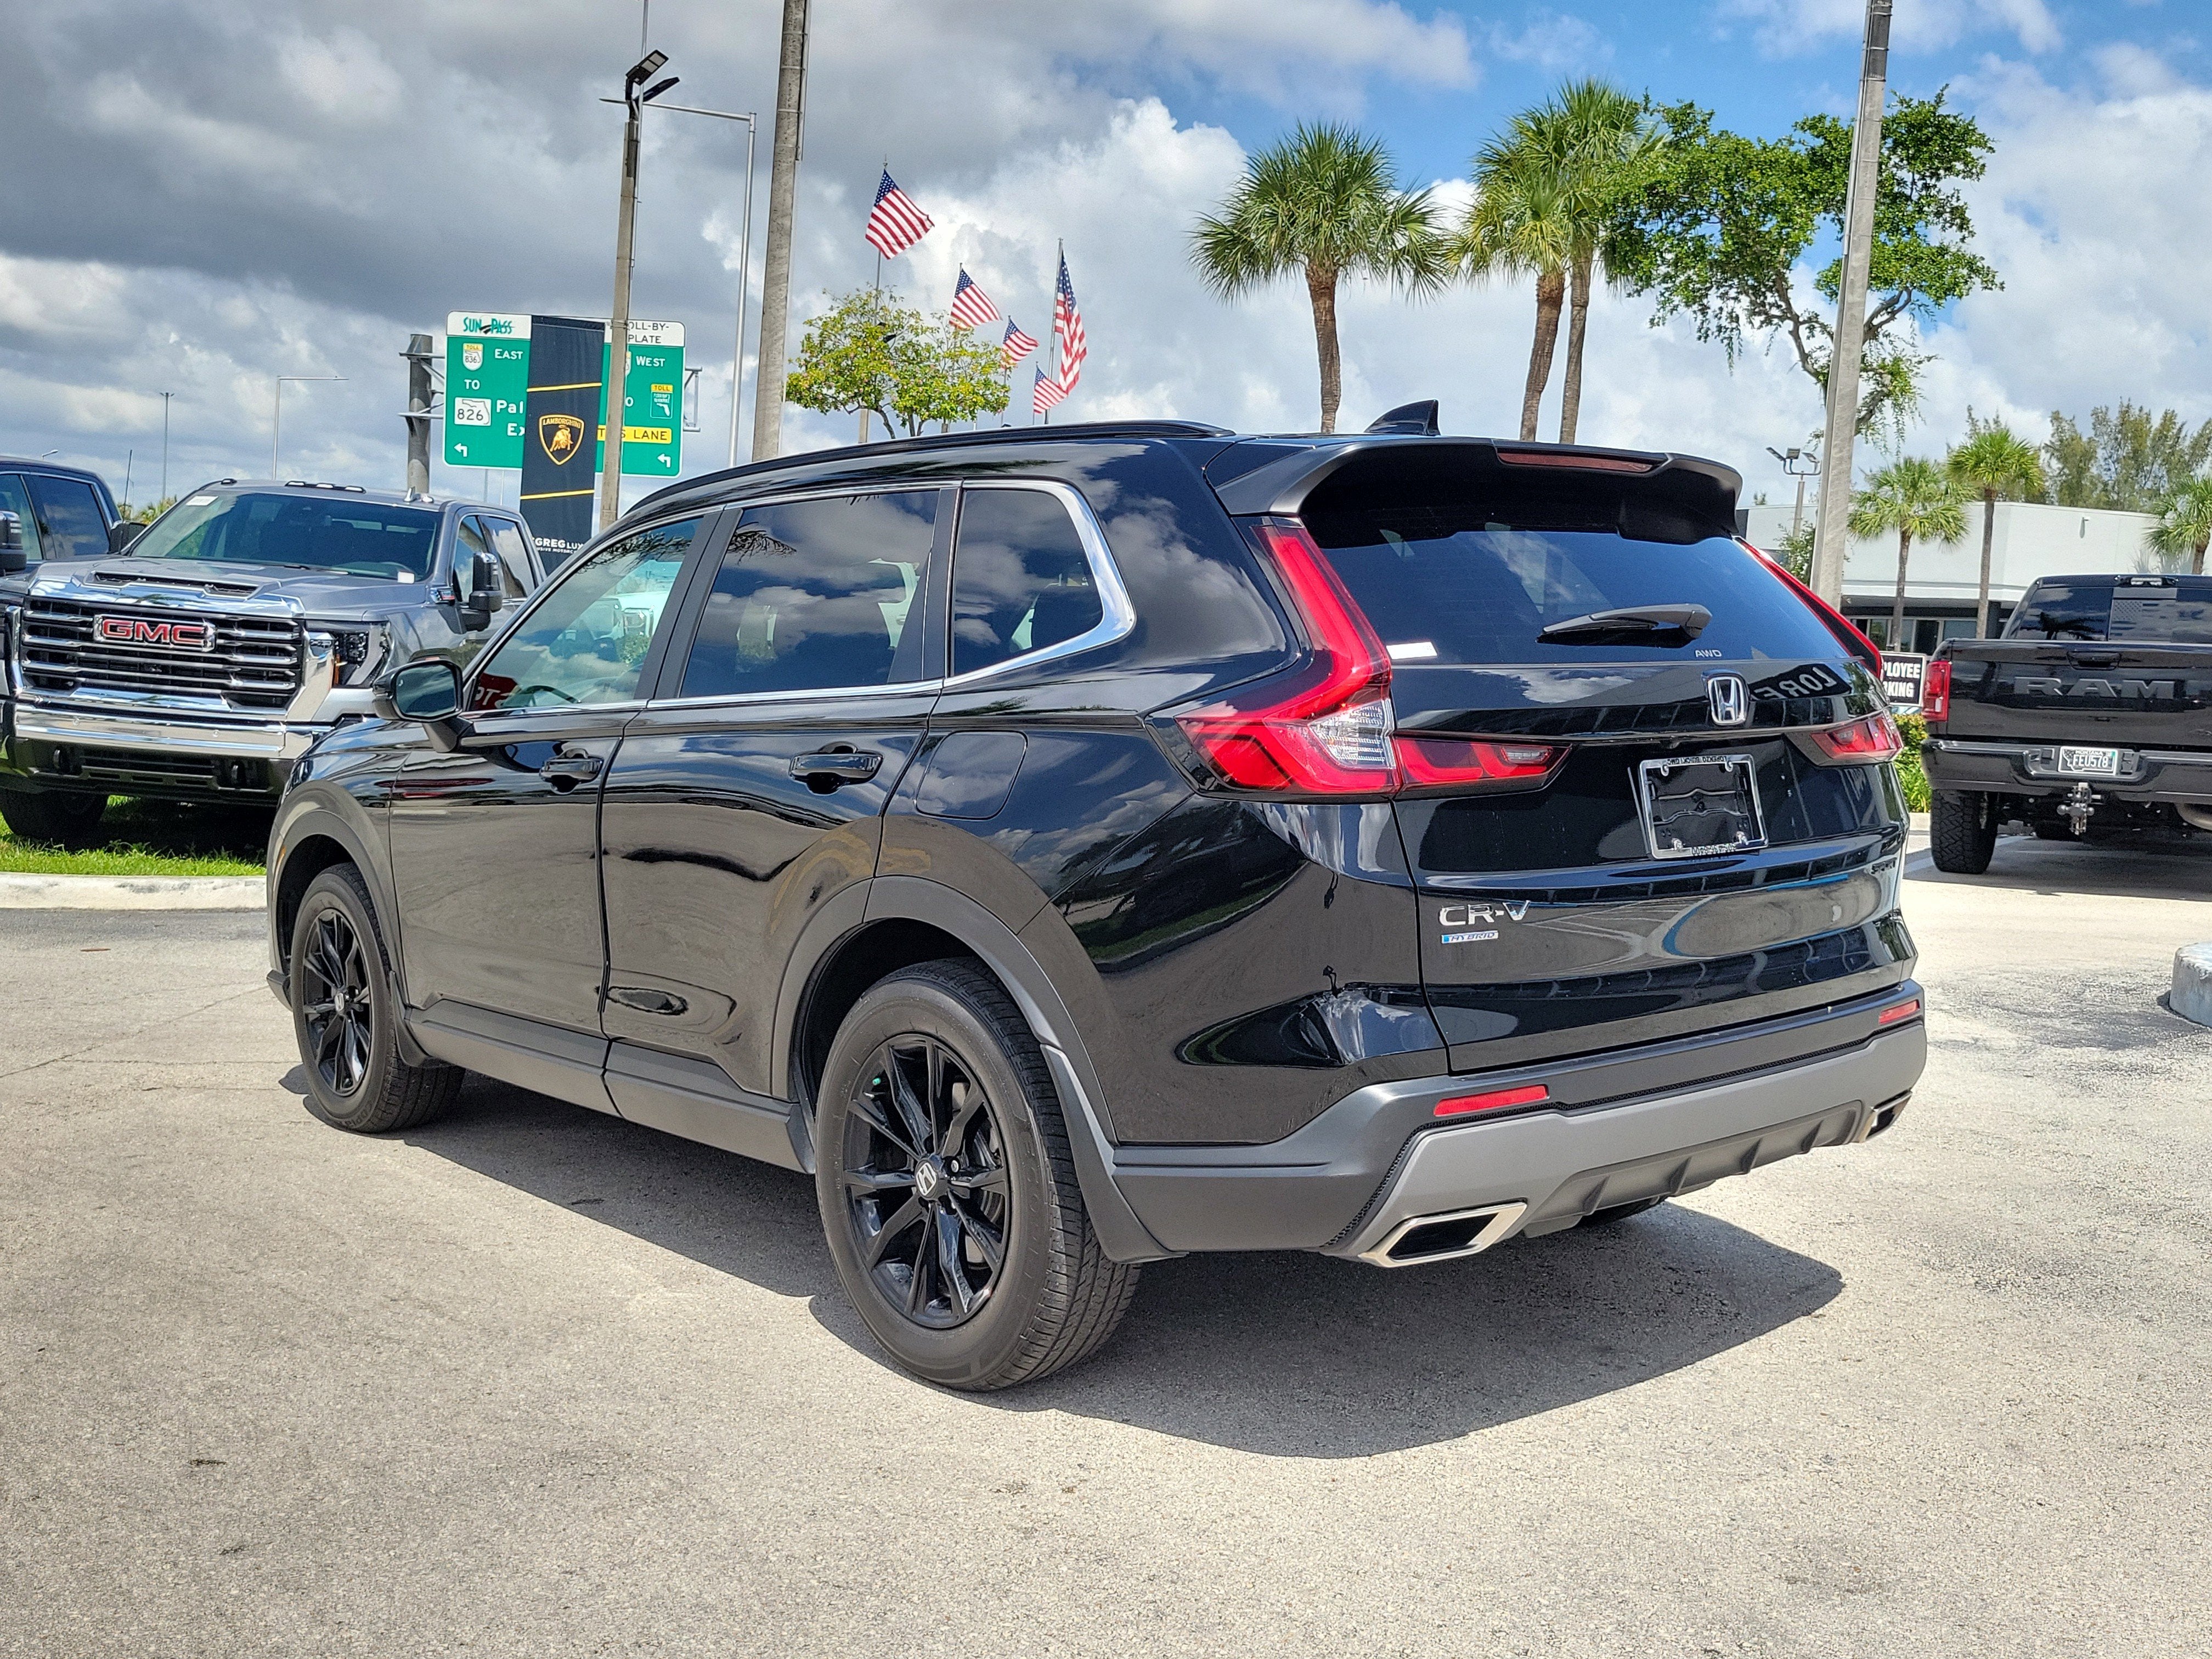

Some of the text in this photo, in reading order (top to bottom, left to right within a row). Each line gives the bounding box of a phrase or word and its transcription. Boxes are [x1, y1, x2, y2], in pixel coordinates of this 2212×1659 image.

[463, 317, 482, 332] SUN
[629, 321, 669, 331] OLL-BY-
[628, 334, 662, 343] PLATE
[465, 355, 478, 363] 836
[494, 348, 524, 360] EAST
[636, 356, 666, 367] WEST
[464, 379, 481, 390] TO
[625, 396, 634, 407] O
[457, 408, 484, 421] 826
[634, 430, 668, 441] LANE
[533, 537, 566, 548] GREG
[102, 619, 205, 644] GMC
[1695, 649, 1723, 658] AWD
[2014, 676, 2175, 699] RAM
[2073, 754, 2109, 768] FEU578
[1439, 900, 1531, 926] CR-V
[1451, 932, 1495, 942] HYBRID
